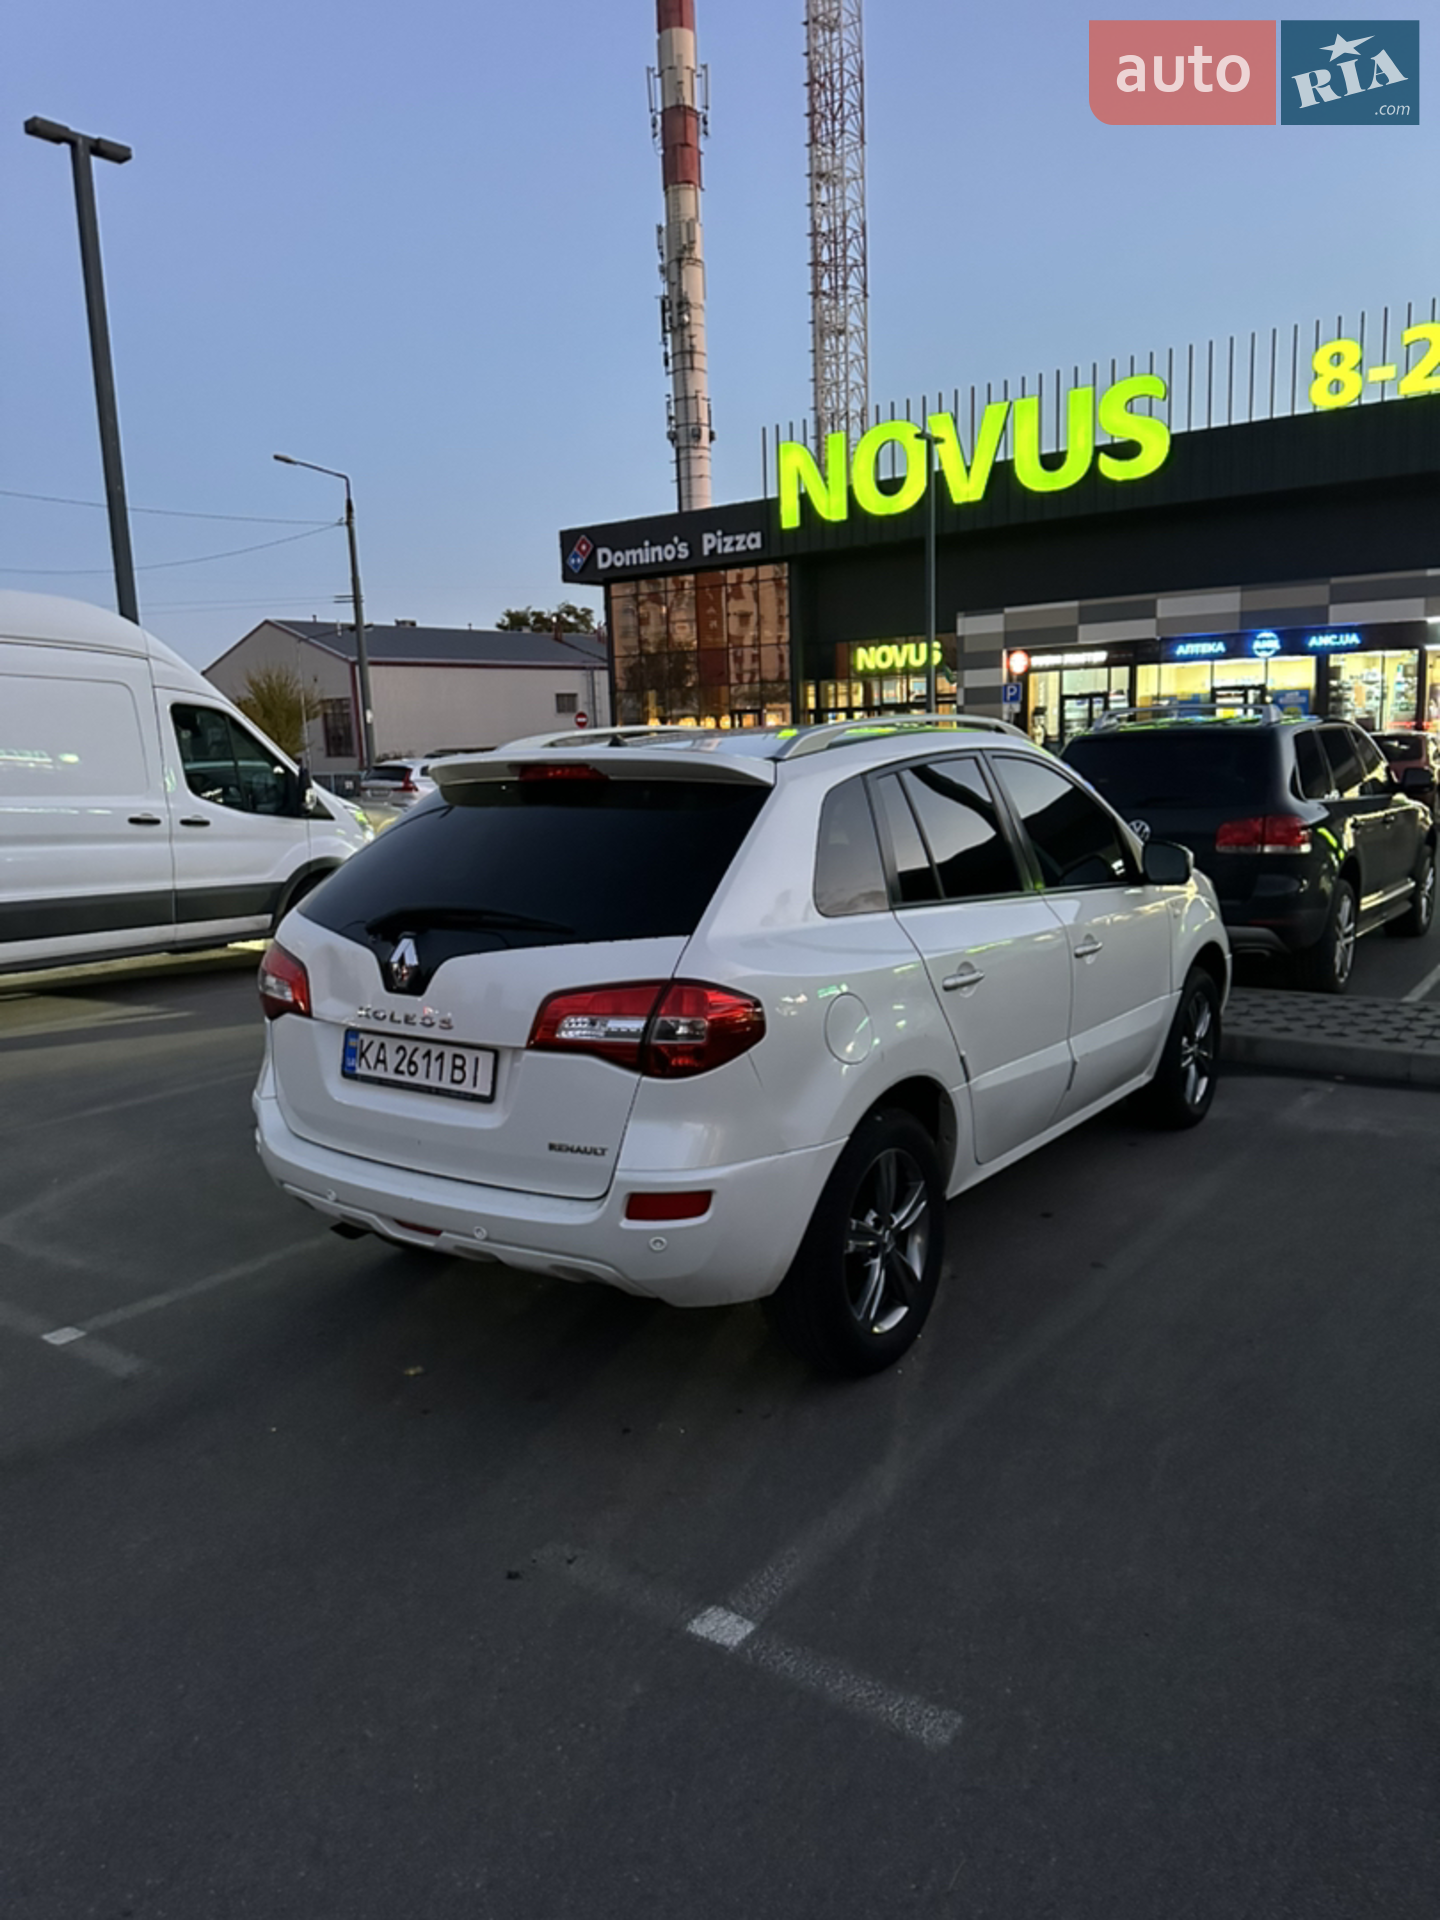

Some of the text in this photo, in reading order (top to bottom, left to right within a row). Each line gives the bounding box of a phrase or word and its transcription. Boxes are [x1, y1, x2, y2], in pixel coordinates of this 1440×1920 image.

[778, 374, 1171, 529] NOVUS
[596, 530, 762, 570] Domino's Pizza
[856, 641, 943, 671] NOVUS
[1175, 641, 1226, 656] АПТЕКА
[357, 1006, 454, 1030] KOLEOS
[548, 1142, 608, 1157] RENAULT
